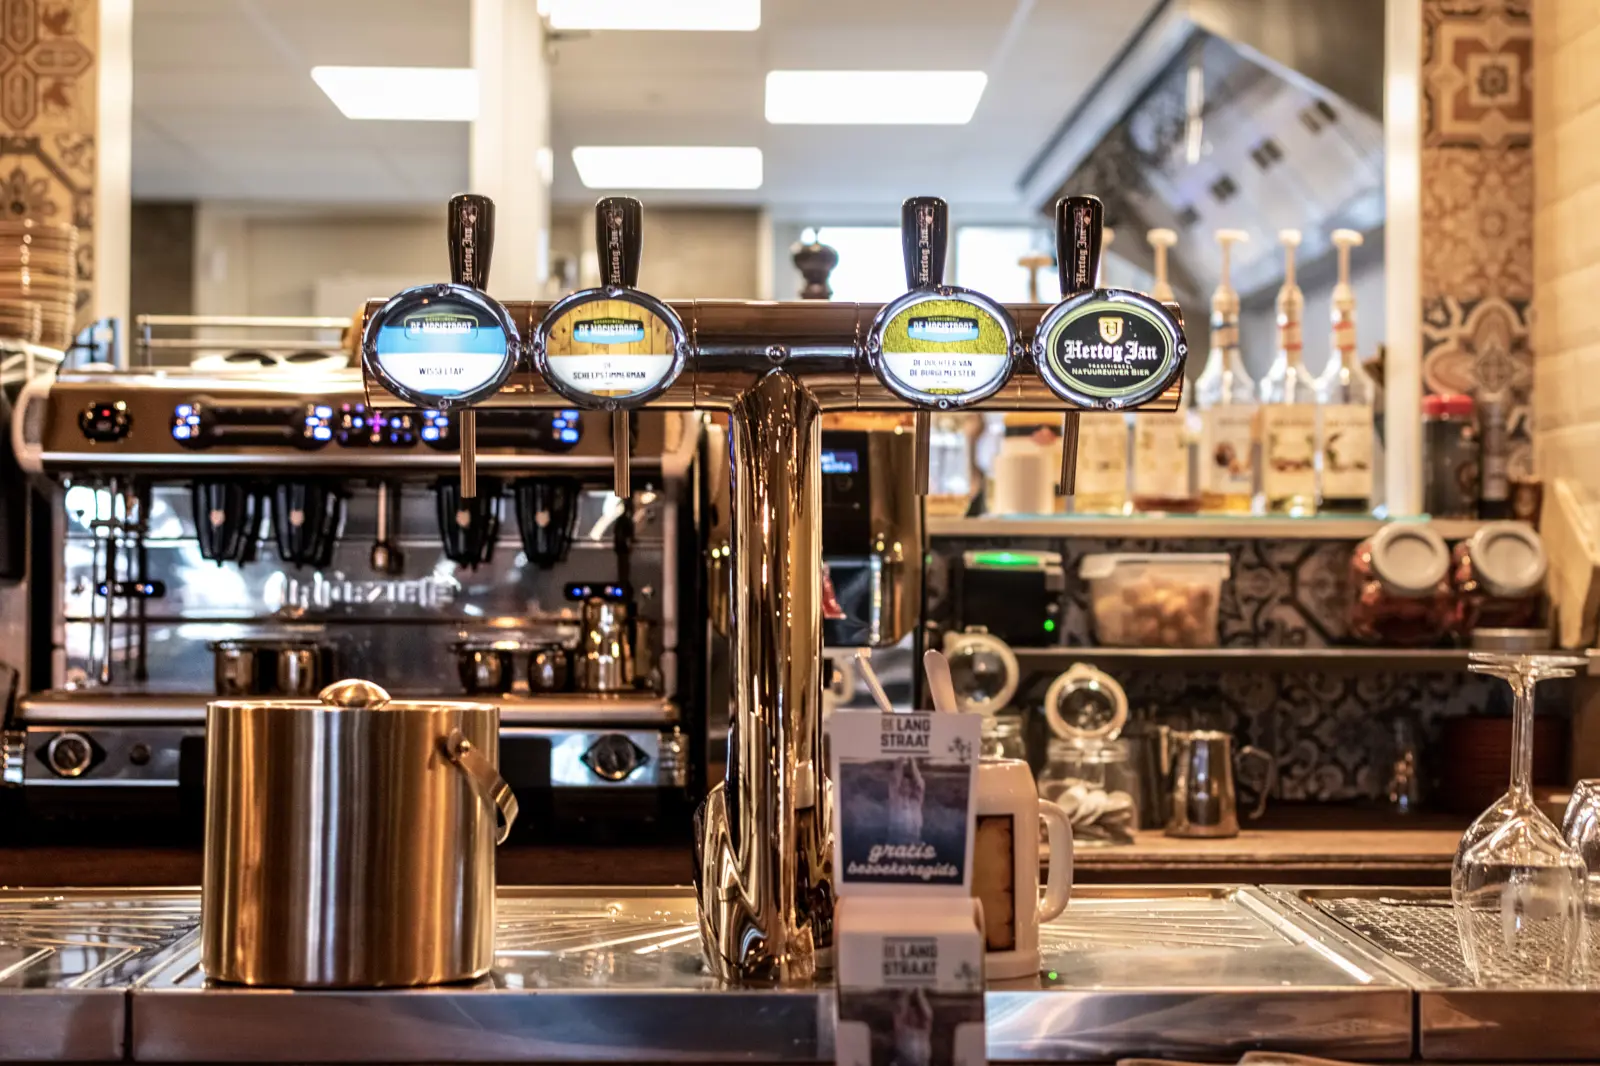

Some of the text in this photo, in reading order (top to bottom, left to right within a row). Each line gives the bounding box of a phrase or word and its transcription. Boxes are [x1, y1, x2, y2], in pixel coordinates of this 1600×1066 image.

[462, 227, 474, 283] Hertog Jan
[609, 229, 621, 285] Hertog Jan
[918, 226, 930, 285] Hertog Jan
[1076, 227, 1088, 285] Hertog Jan
[1063, 339, 1157, 365] Hertog Jan
[909, 369, 918, 377] DE
[1131, 368, 1150, 376] BIER
[896, 718, 931, 732] LANG
[881, 733, 930, 747] STRAAT
[868, 842, 937, 863] gratis
[883, 960, 937, 976] STRAAT
